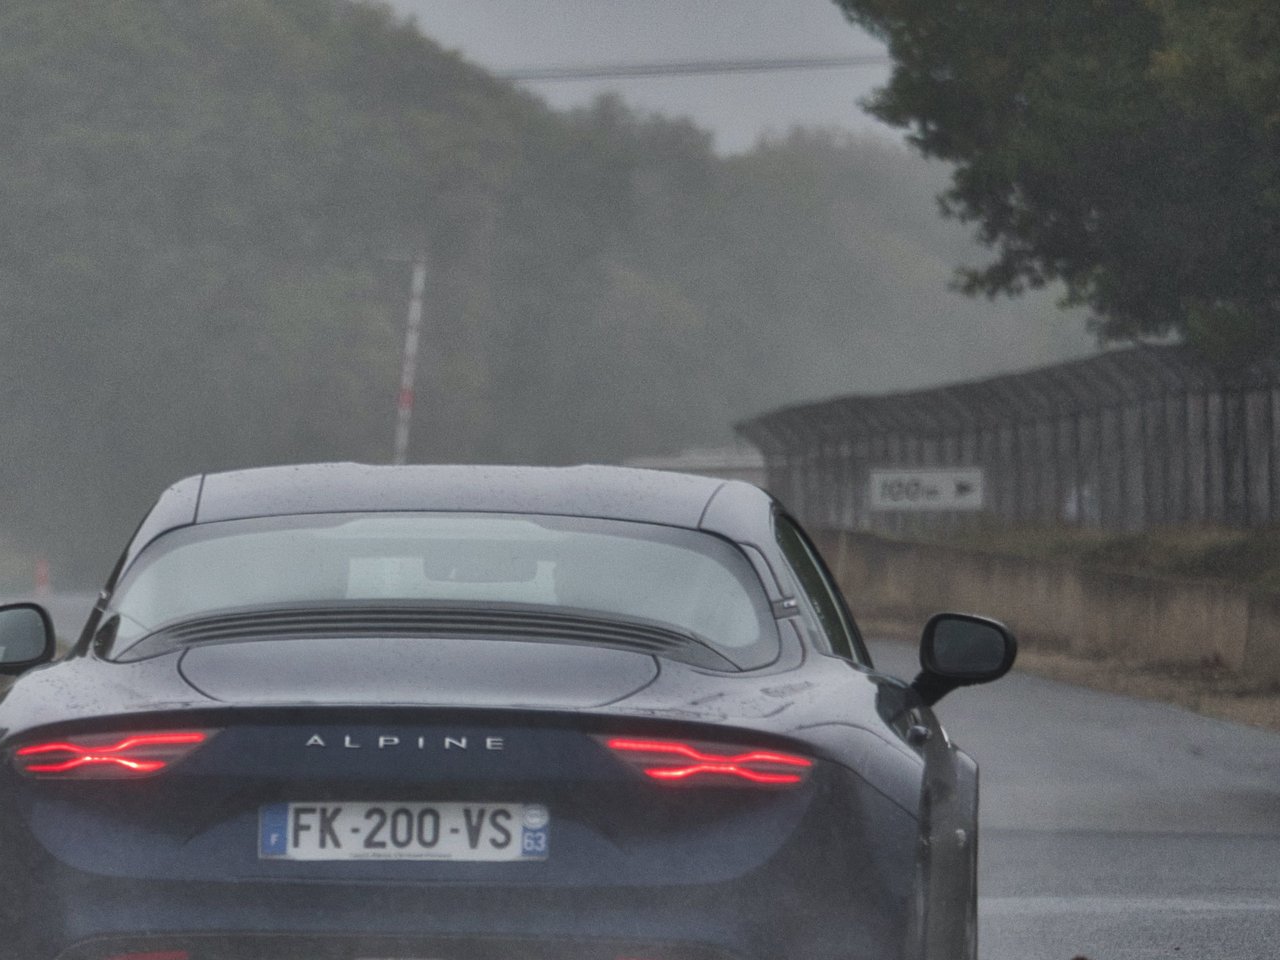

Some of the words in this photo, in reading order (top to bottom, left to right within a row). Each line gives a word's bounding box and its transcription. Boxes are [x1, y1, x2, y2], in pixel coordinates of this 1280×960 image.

[305, 734, 505, 750] ALPINE
[292, 807, 513, 849] FK-200-VS
[270, 833, 279, 846] F
[523, 831, 546, 851] 63
